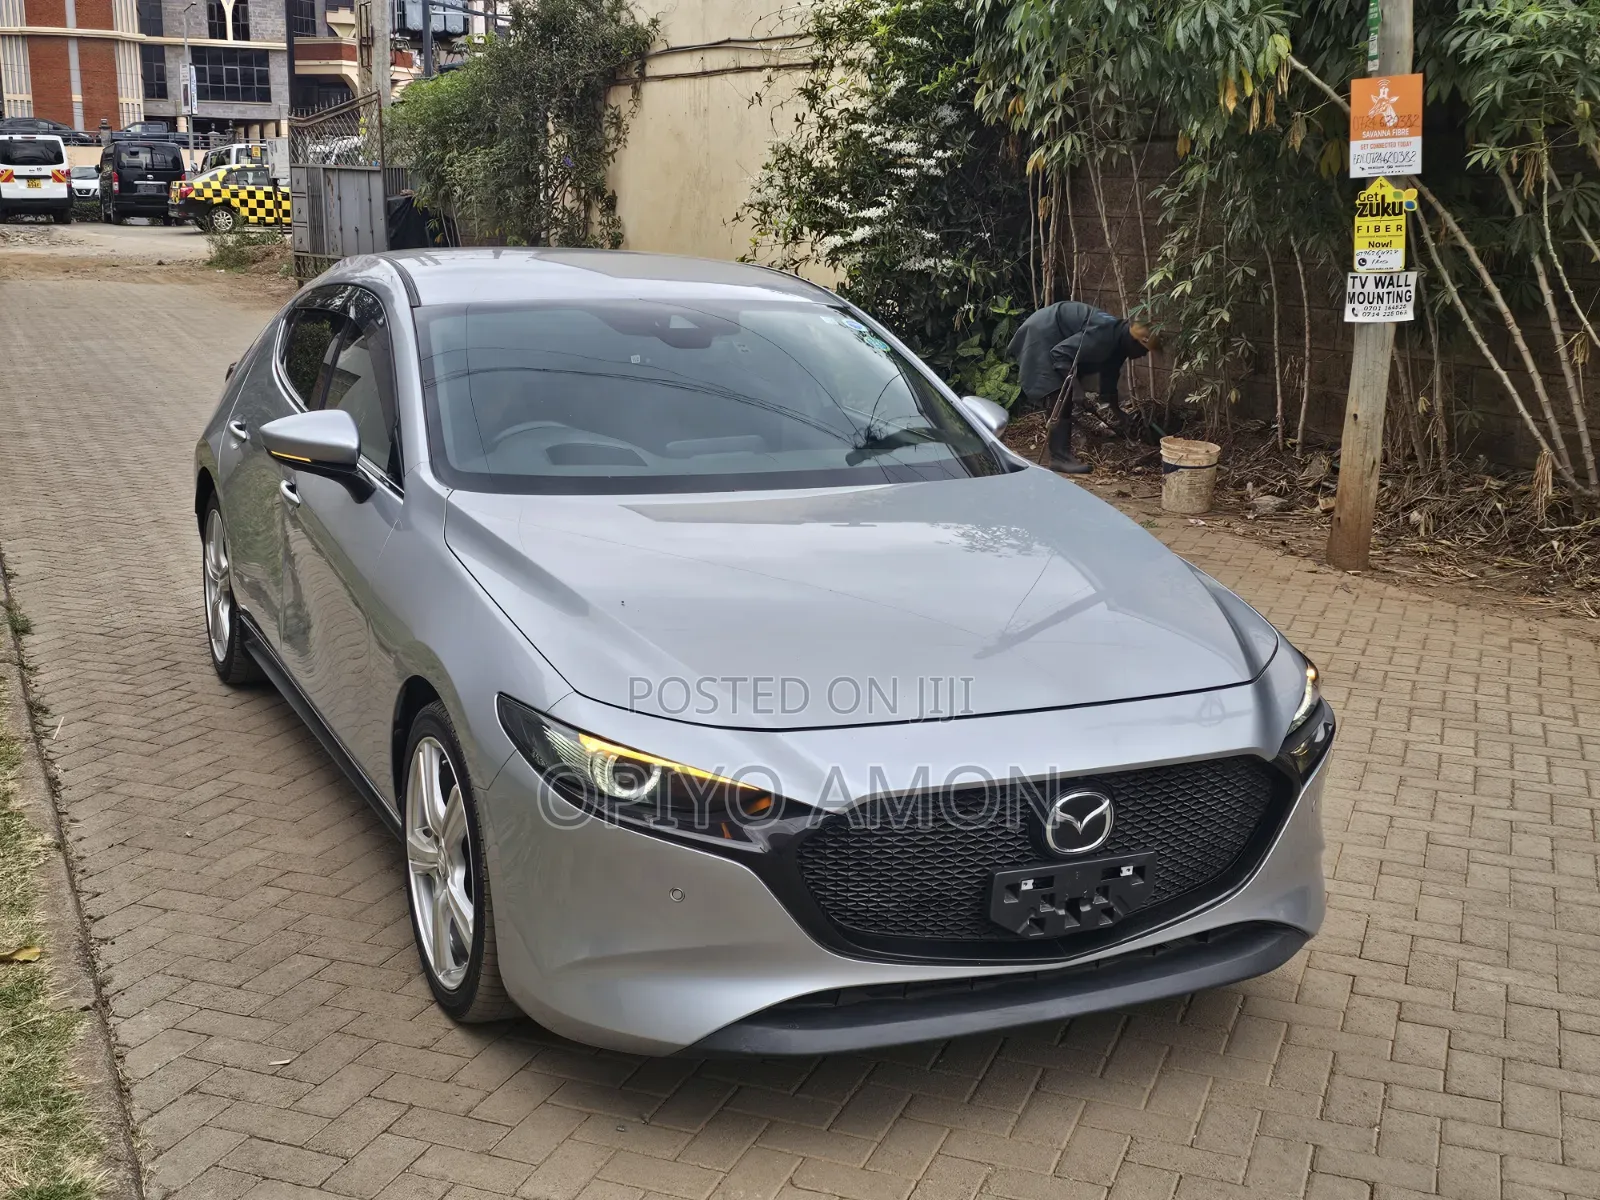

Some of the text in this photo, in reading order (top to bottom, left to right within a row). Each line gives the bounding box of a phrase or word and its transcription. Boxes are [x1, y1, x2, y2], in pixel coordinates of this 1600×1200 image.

[1362, 128, 1410, 138] SAVANNA FIBRE
[1358, 192, 1379, 202] Get
[1357, 194, 1403, 217] zuku
[1357, 225, 1403, 233] FIBER
[1368, 240, 1392, 248] Now!
[1350, 275, 1411, 289] TV WALL
[1348, 290, 1412, 304] MOUNTING
